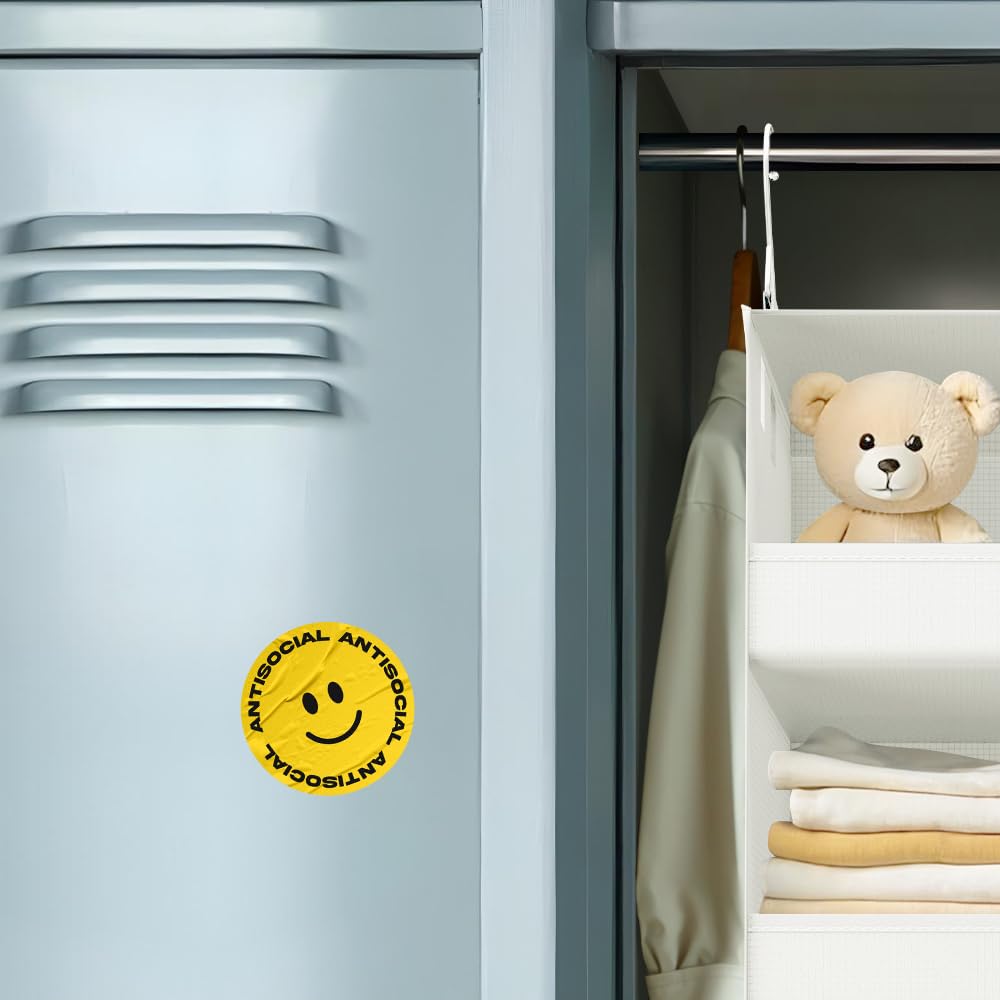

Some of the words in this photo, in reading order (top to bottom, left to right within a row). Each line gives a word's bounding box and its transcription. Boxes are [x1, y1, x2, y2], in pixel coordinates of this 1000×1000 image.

[248, 630, 330, 732] ANTISOCIAL
[338, 632, 407, 745] ANTISOCIAL
[264, 743, 386, 788] ANTISOCIAL
